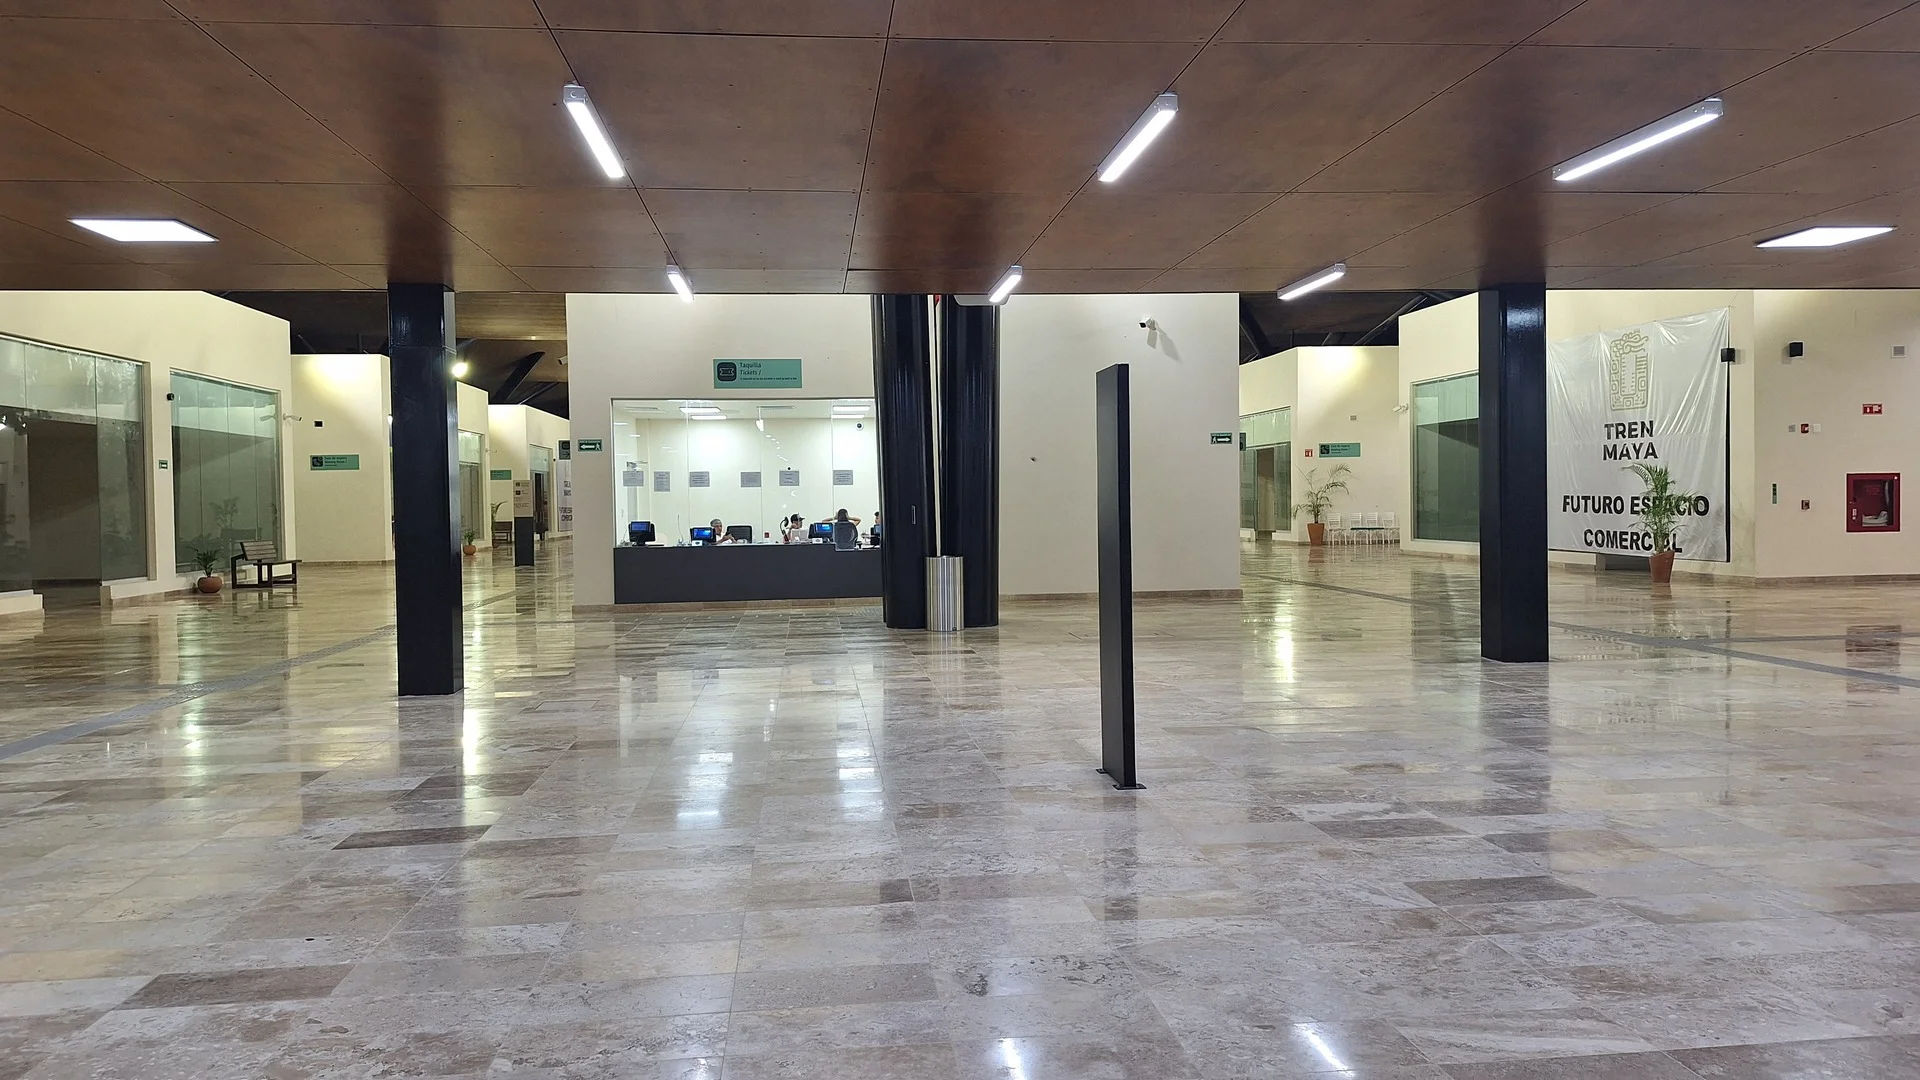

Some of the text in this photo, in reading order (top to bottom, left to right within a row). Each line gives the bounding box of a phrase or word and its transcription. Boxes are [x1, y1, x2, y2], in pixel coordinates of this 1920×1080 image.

[1604, 420, 1654, 440] TREN
[1602, 442, 1659, 461] MAYA
[1562, 495, 1625, 515] FUTURO
[1583, 528, 1683, 553] COMERCAL
